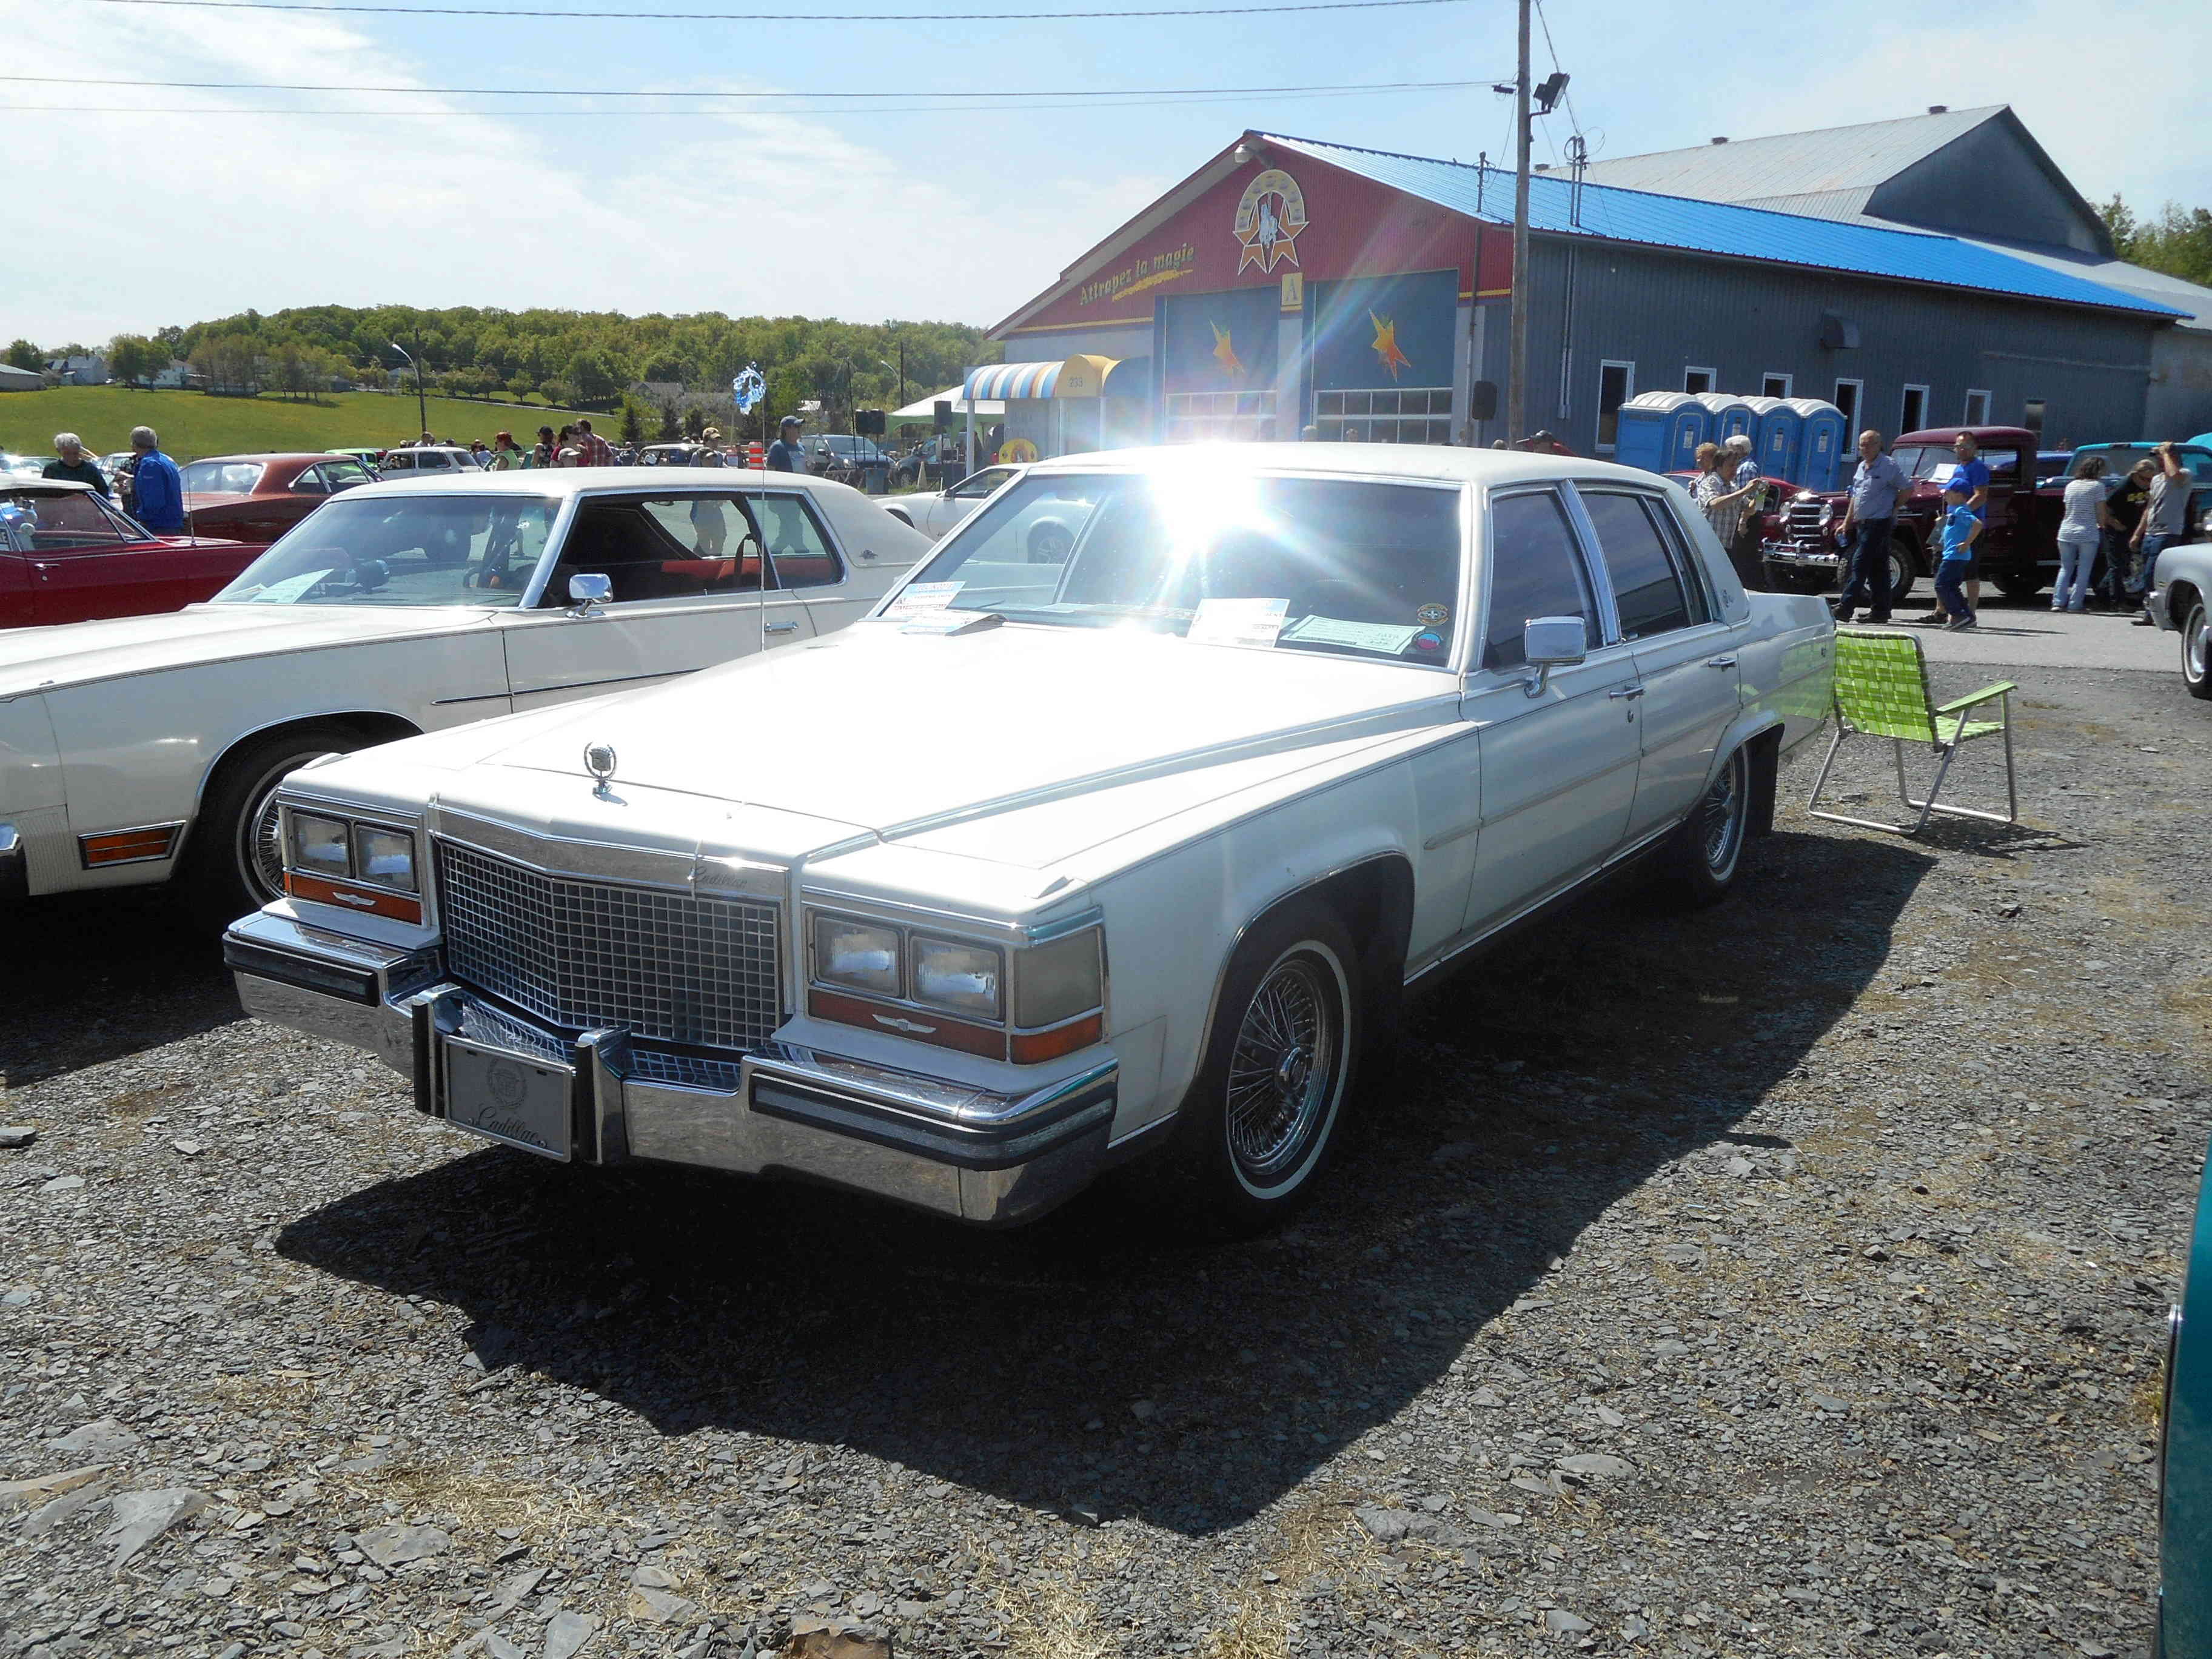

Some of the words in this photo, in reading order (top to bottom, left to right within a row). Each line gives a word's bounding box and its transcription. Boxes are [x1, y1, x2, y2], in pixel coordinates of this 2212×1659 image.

[1080, 269, 1132, 305] Attrapez
[1135, 259, 1150, 278] la
[1153, 243, 1194, 269] magie
[1285, 277, 1299, 301] A
[471, 1105, 540, 1142] Cadillac
